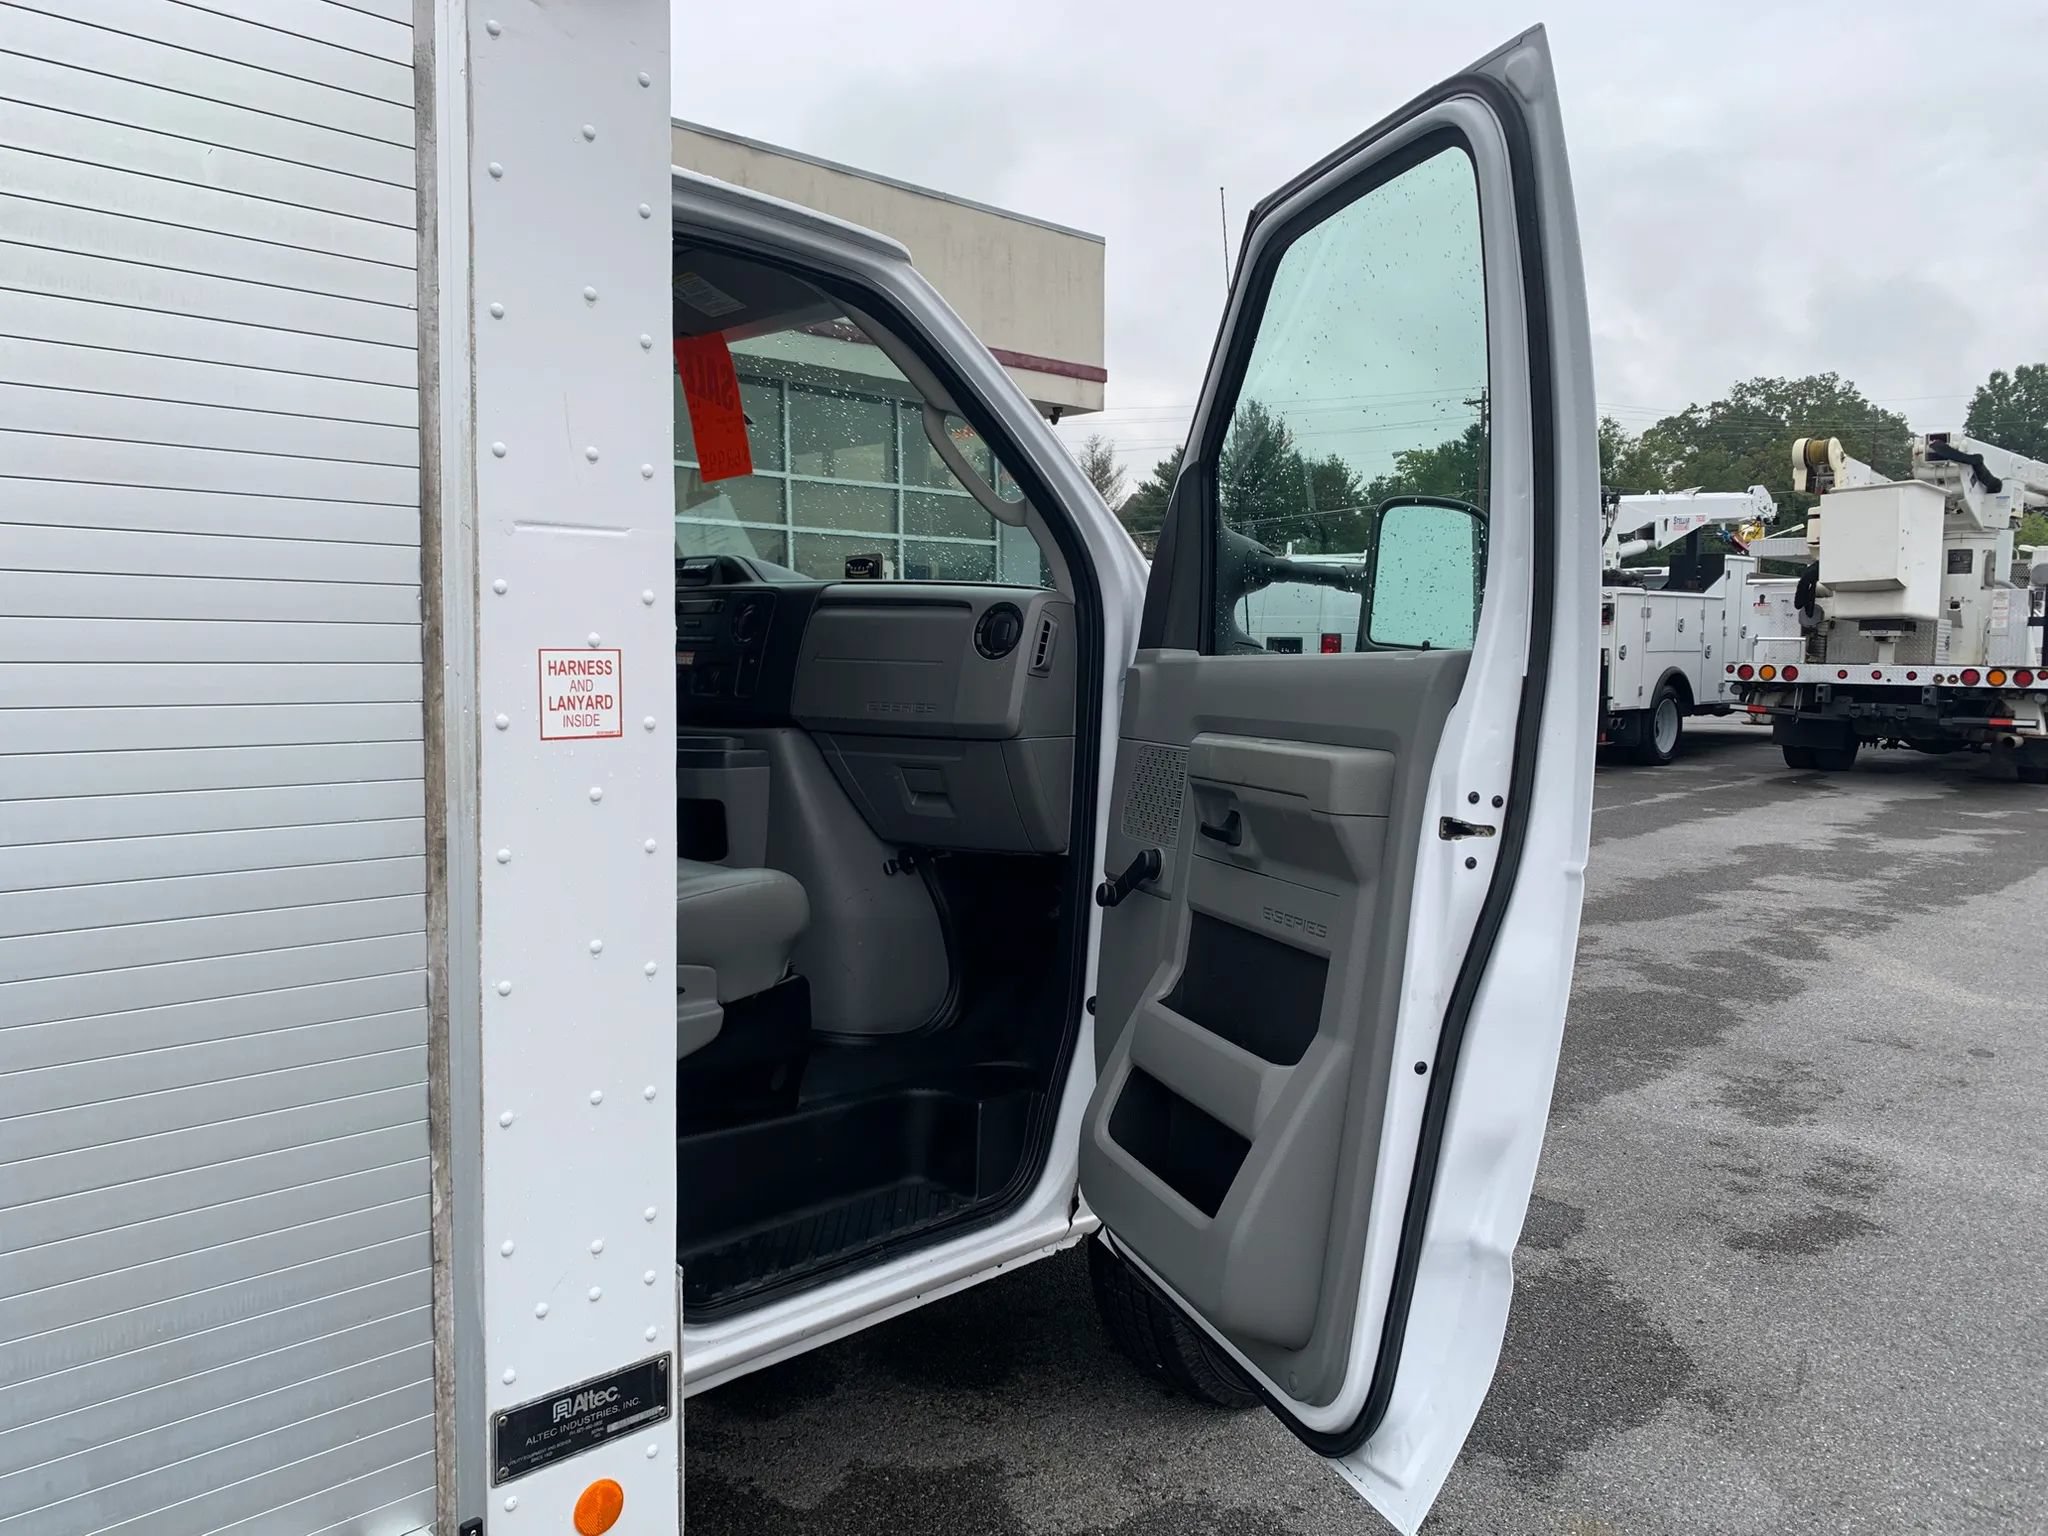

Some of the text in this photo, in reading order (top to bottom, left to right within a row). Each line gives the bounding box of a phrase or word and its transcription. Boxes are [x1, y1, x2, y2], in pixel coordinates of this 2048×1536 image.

[548, 660, 612, 676] HARNESS
[569, 679, 593, 692] AND
[549, 695, 613, 711] LANYARD
[563, 714, 600, 728] INSIDE
[571, 1386, 619, 1416] Altec
[526, 1427, 558, 1447] ALTEC
[623, 1397, 641, 1410] INC.
